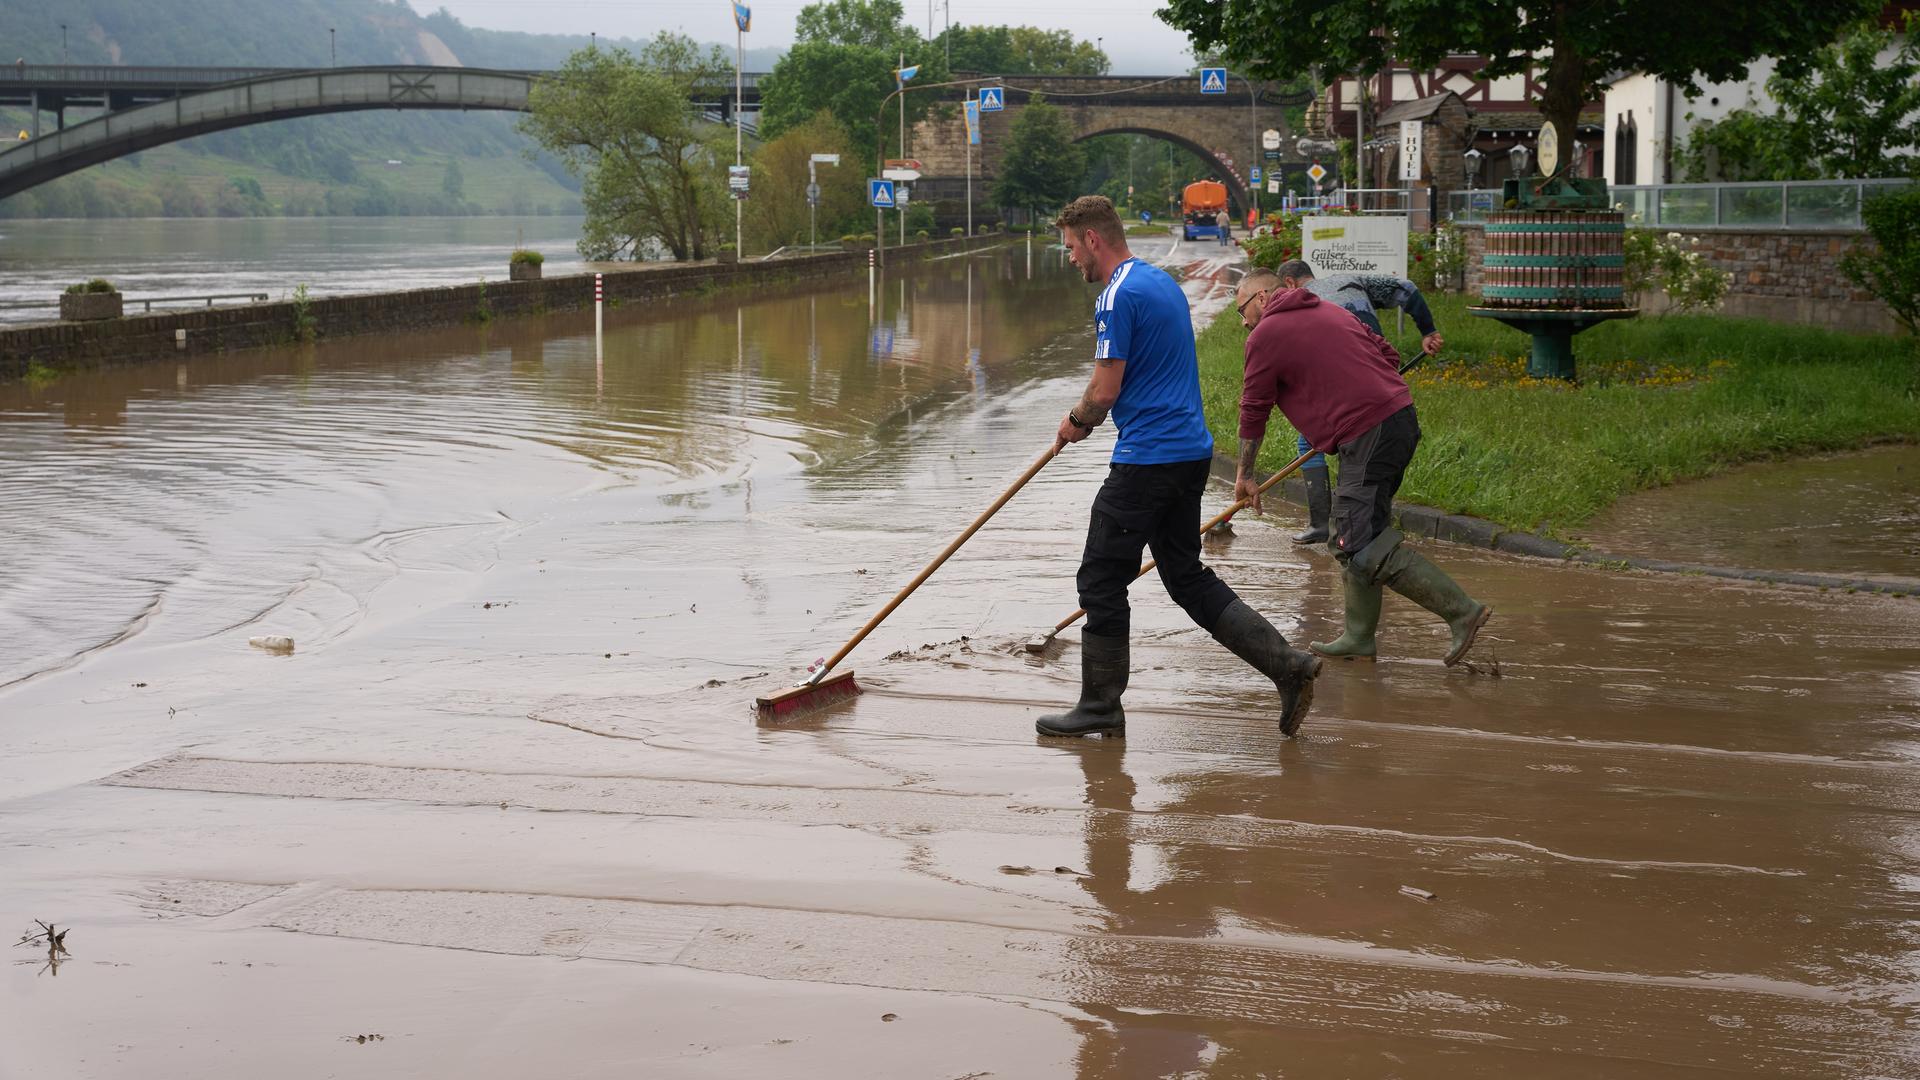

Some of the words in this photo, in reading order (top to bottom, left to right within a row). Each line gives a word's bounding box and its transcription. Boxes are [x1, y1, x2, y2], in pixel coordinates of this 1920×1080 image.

[1405, 137, 1417, 177] HOTEL
[1331, 242, 1354, 252] Hotel
[1311, 248, 1346, 262] Gülser
